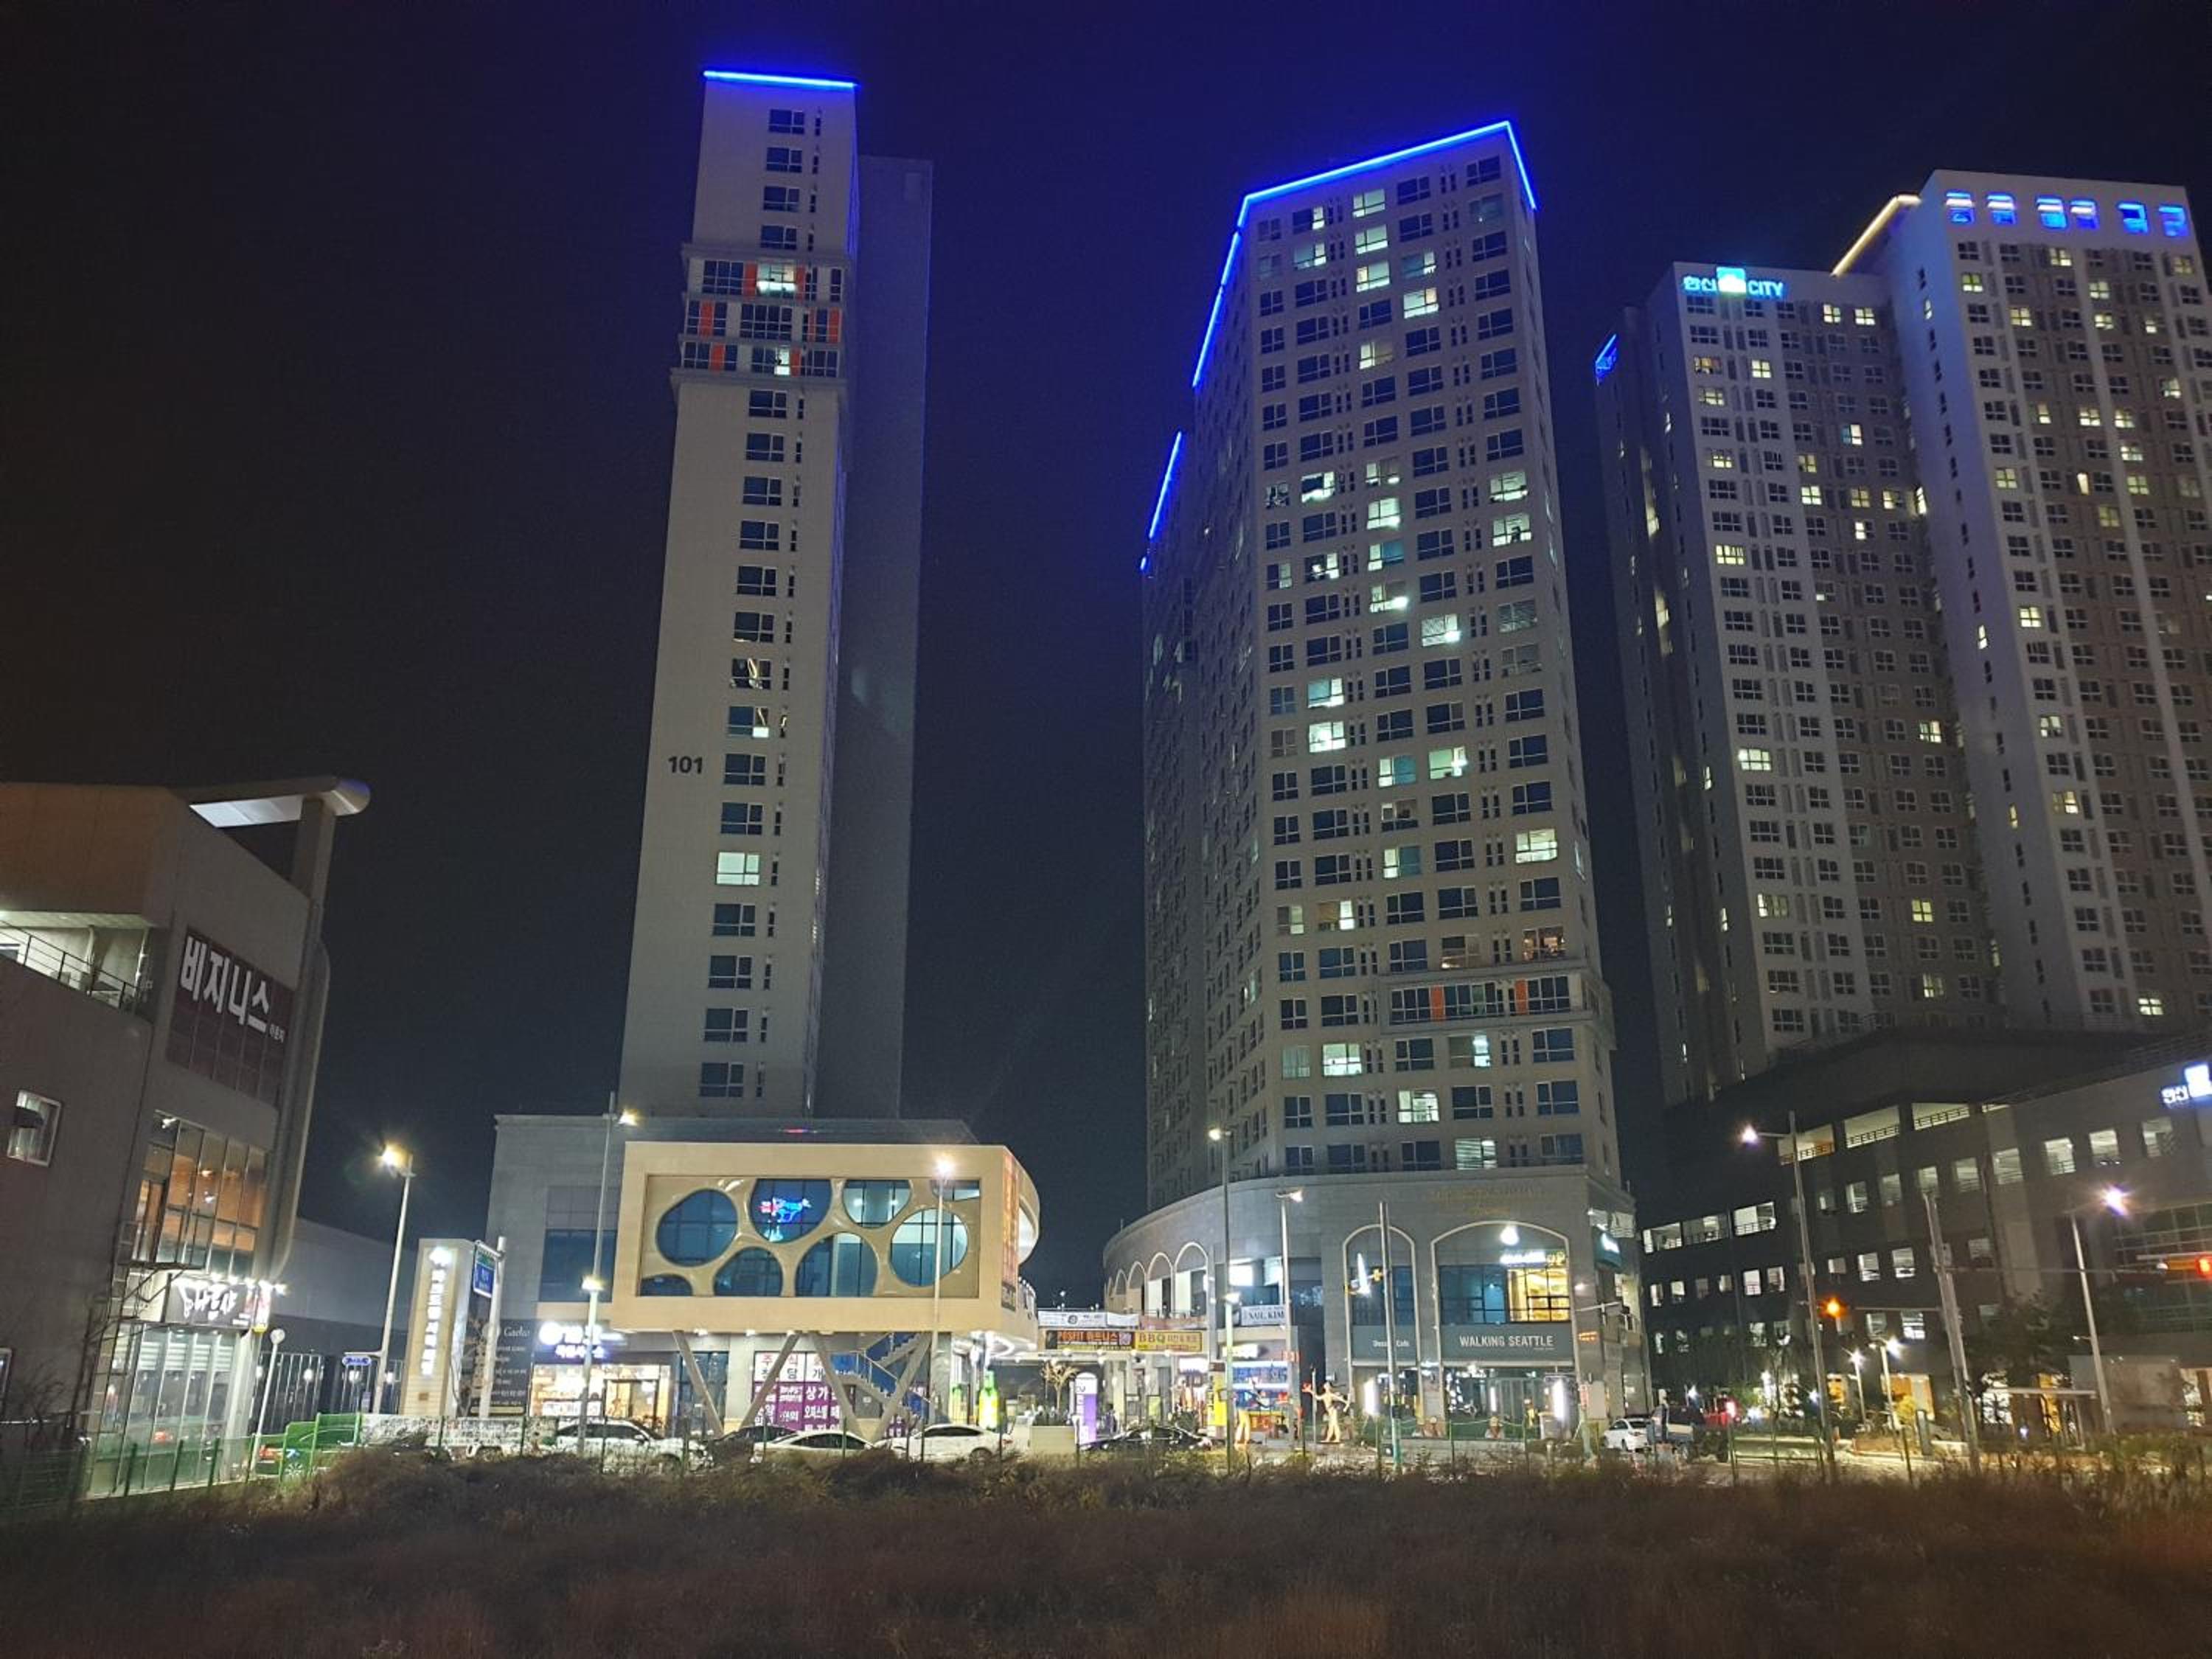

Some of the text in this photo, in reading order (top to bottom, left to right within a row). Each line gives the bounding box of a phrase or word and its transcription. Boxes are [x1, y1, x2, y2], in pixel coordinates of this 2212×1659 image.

[1748, 280, 1783, 296] CITY
[668, 756, 703, 774] 101
[181, 935, 269, 1033] 비지니스
[1139, 1332, 1166, 1344] BBQ
[1459, 1335, 1554, 1346] WALKING SEATTLE
